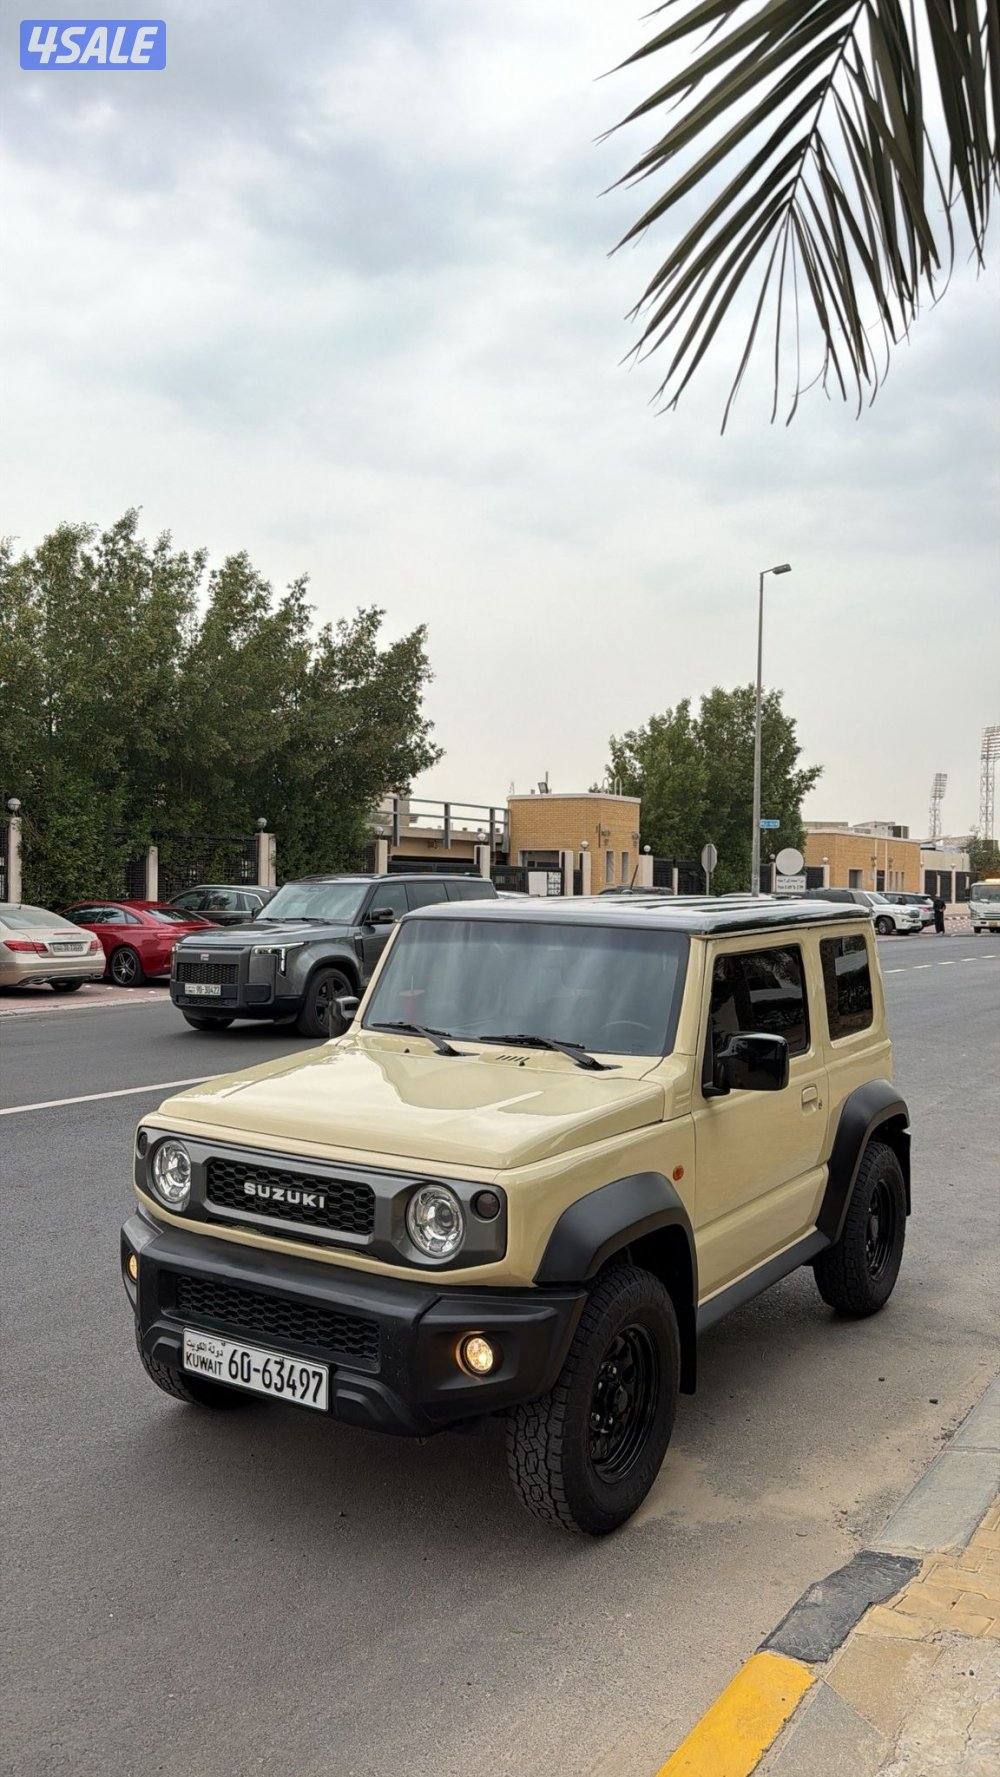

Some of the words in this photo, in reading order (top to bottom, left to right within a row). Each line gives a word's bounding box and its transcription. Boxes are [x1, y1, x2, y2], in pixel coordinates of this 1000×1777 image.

[243, 1182, 325, 1209] SUZUKI
[186, 1339, 208, 1353] الكويت
[208, 1342, 224, 1358] دولة
[185, 1352, 224, 1376] KUWAIT
[228, 1349, 323, 1403] 60-63497
